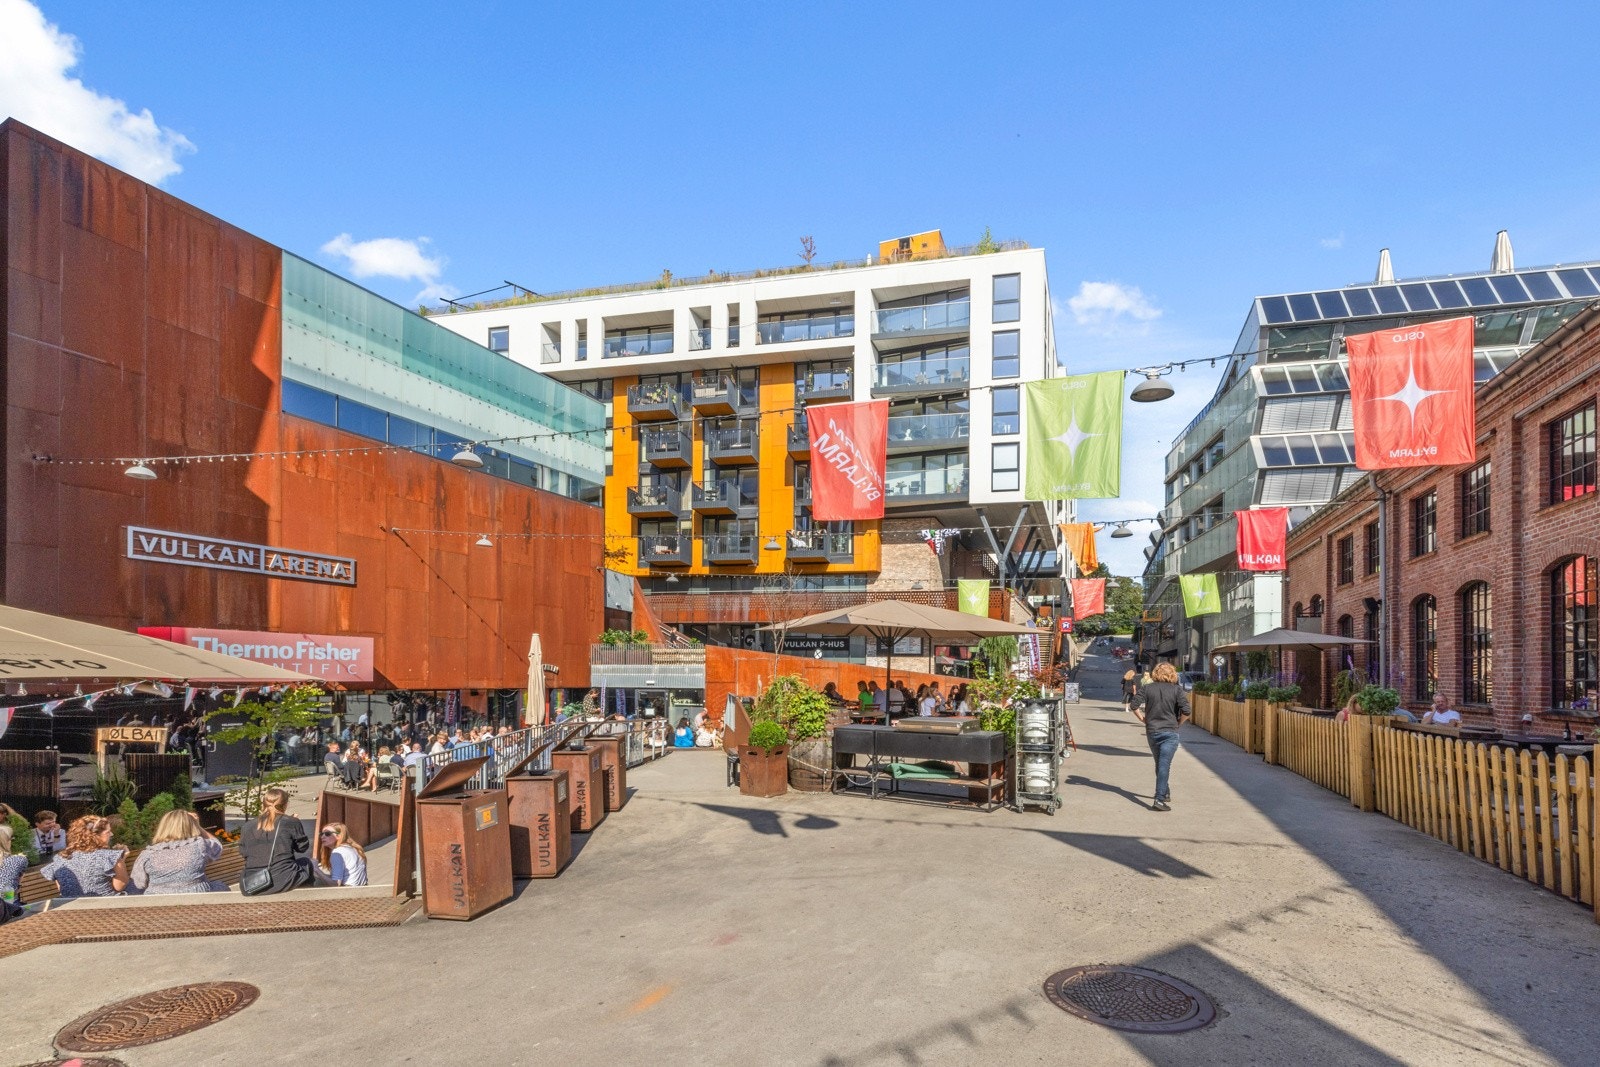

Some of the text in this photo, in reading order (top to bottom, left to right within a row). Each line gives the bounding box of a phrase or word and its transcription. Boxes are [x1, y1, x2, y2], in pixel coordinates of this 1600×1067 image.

[138, 534, 348, 578] VULKAN ARENA
[110, 728, 129, 740] ØL
[538, 813, 551, 868] VULKAN
